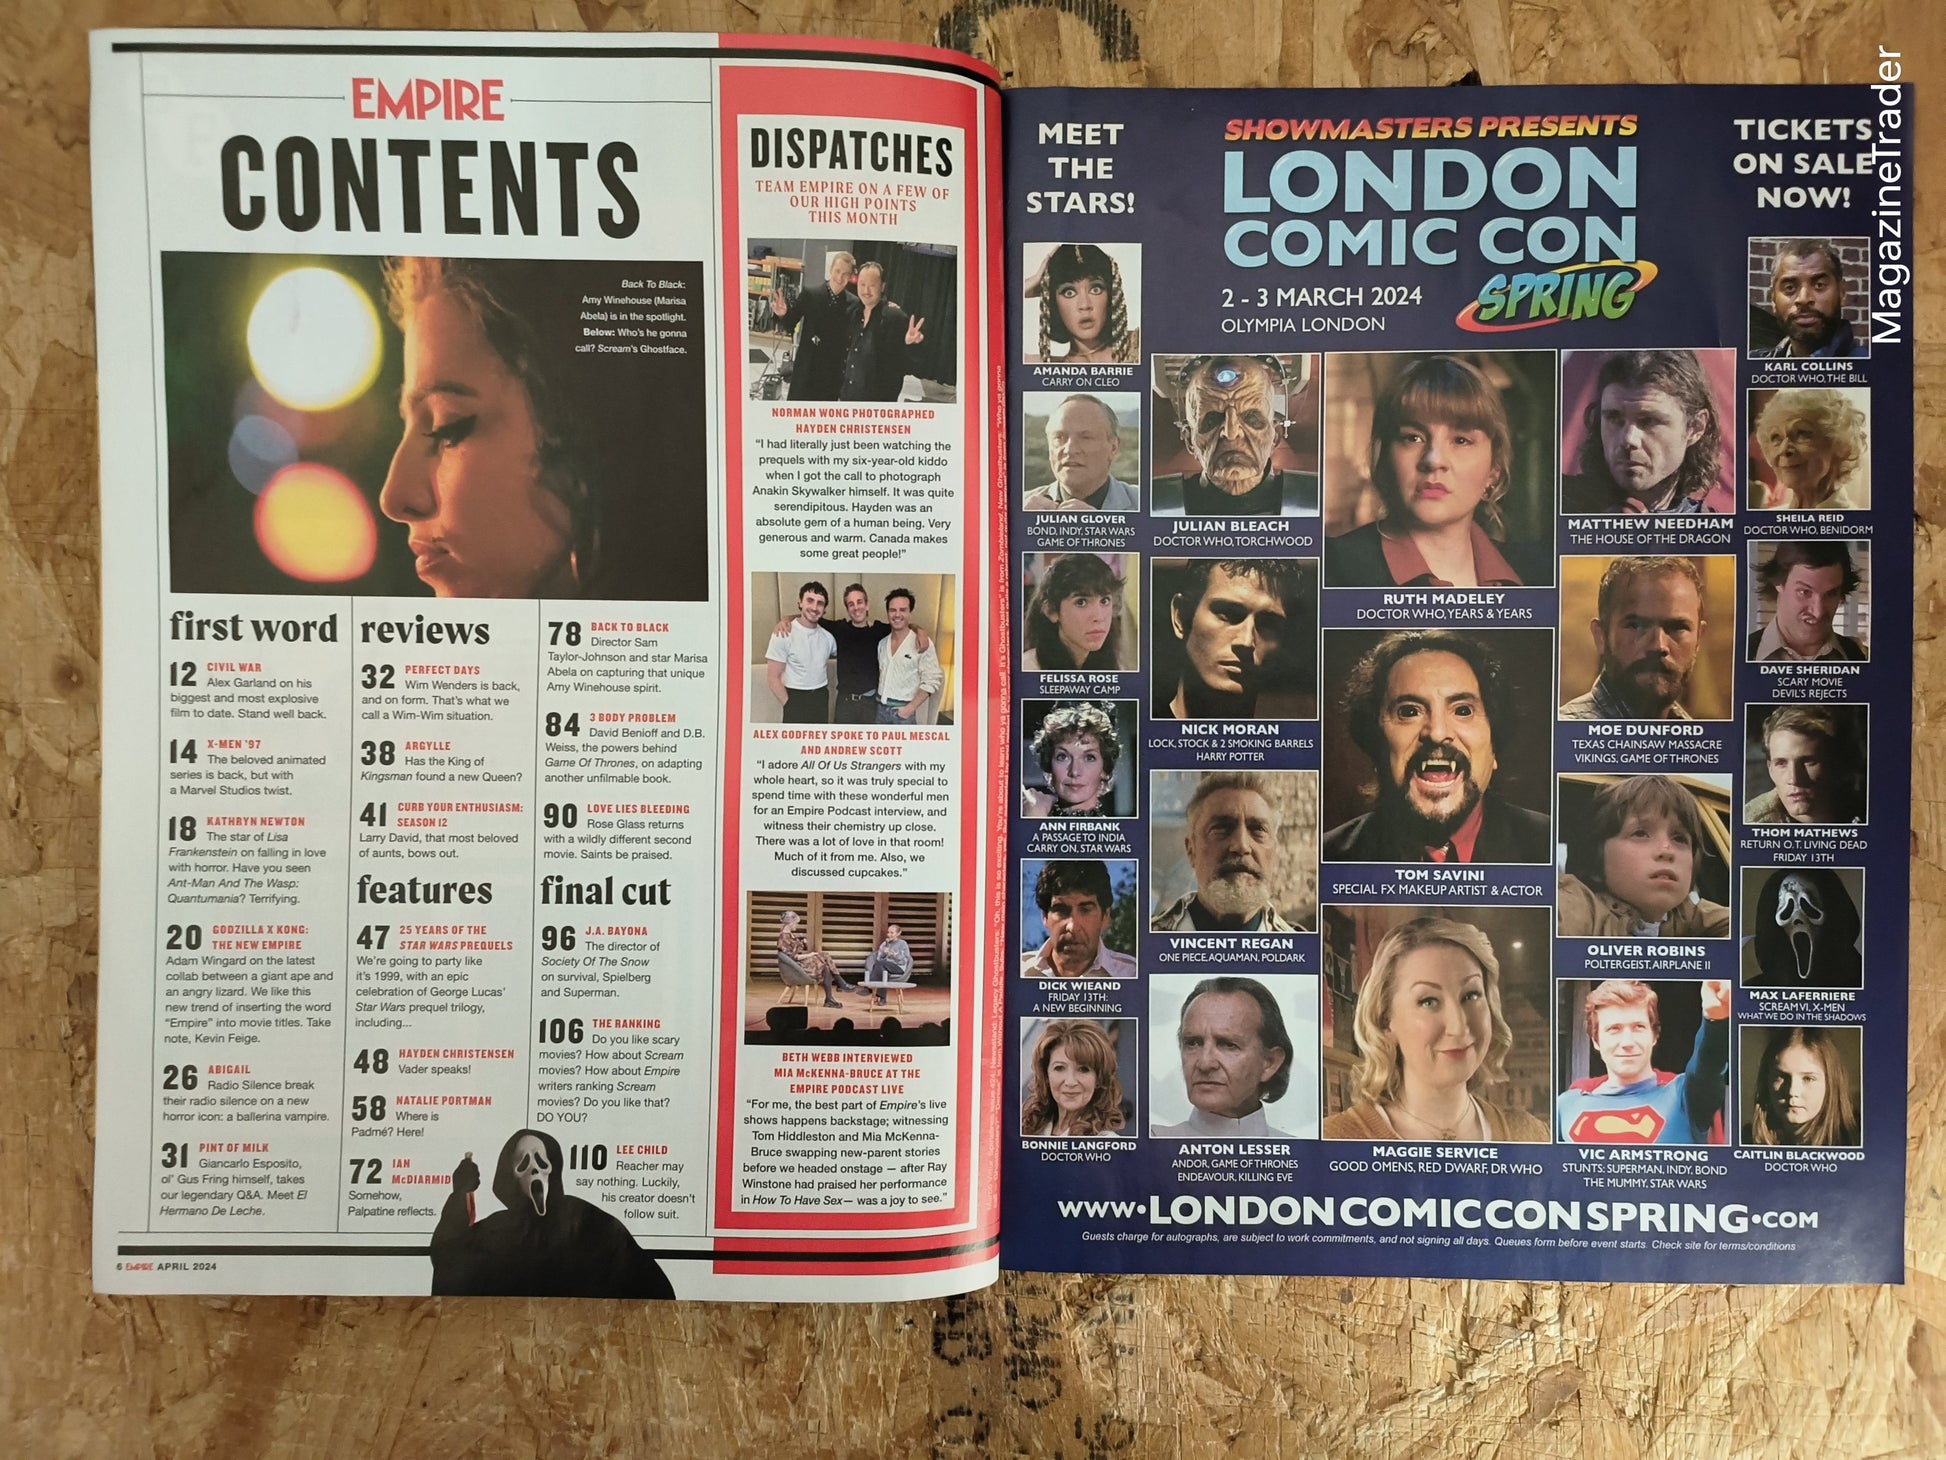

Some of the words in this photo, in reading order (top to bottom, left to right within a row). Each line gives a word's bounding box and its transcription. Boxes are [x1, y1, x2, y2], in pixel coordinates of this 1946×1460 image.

[351, 77, 504, 121] EMPIRE
[1038, 122, 1124, 144] MEET
[1224, 117, 1472, 141] SHOWMASTERS
[1479, 114, 1637, 138] PRESENTS
[1734, 119, 1872, 141] TICKETS
[751, 125, 955, 177] DISPATCHES
[1047, 157, 1113, 179] THE
[1733, 153, 1782, 175] ON
[1794, 153, 1873, 175] SALE
[220, 134, 639, 239] CONTENTS
[1223, 147, 1637, 213] LONDON
[755, 179, 793, 193] TEAM
[799, 180, 853, 195] EMPIRE
[858, 182, 877, 195] ON
[882, 183, 891, 196] A
[897, 184, 926, 199] FEW
[932, 186, 949, 201] OF
[1757, 186, 1850, 208] NOW!
[789, 194, 819, 208] OUR
[824, 195, 859, 210] HIGH
[864, 197, 916, 212] POINTS
[1026, 191, 1134, 213] STARS!
[808, 209, 841, 224] THIS
[846, 210, 897, 226] MONTH
[1223, 219, 1457, 268] COMIC
[1479, 215, 1637, 264] CON
[621, 278, 644, 289] Back
[646, 278, 657, 289] To
[658, 279, 686, 289] Black:
[1222, 288, 1234, 307] 2
[1257, 287, 1268, 307] 3
[1276, 286, 1363, 307] MARCH
[1371, 285, 1422, 305] 2024
[1477, 270, 1635, 322] SPRING
[1221, 317, 1296, 333] OLYMPIA
[1302, 316, 1384, 331] LONDON
[1033, 365, 1087, 376] AMANDA
[1090, 365, 1133, 376] BARRIE
[1764, 361, 1798, 372] KARL
[1801, 361, 1853, 372] COLLINS
[1035, 513, 1077, 526] JULIAN
[1080, 513, 1125, 524] GLOVER
[1567, 517, 1650, 530] MATTHEW
[1654, 517, 1733, 530] NEEDHAM
[1776, 513, 1815, 523] SHEILA
[1818, 513, 1844, 523] REID
[1172, 519, 1225, 535] JULIAN
[1230, 519, 1289, 532] BLEACH
[1383, 592, 1427, 605] RUTH
[1432, 592, 1505, 605] MADELEY
[169, 610, 243, 641] first
[250, 613, 337, 642] word
[360, 614, 489, 644] reviews
[548, 621, 581, 646] 78
[591, 621, 617, 632] BACK
[620, 621, 633, 632] TO
[636, 621, 669, 633] BLACK
[170, 661, 196, 686] 12
[207, 661, 235, 672] CIVIL
[238, 661, 261, 673] WAR
[1760, 664, 1792, 675] DAVE
[1796, 664, 1859, 675] SHERIDAN
[361, 663, 394, 689] 32
[1040, 673, 1085, 683] FELISSA
[1088, 673, 1118, 684] ROSE
[545, 711, 580, 736] 84
[1181, 723, 1218, 735] NICK
[1222, 723, 1279, 736] MORAN
[1588, 723, 1622, 736] MOE
[1626, 723, 1703, 736] DUNFORD
[170, 739, 197, 763] 14
[361, 740, 395, 765] 38
[405, 740, 451, 751] ARGYLLE
[1196, 751, 1227, 762] HARRY
[1229, 751, 1264, 762] POTTER
[359, 802, 386, 826] 41
[543, 802, 579, 830] 90
[587, 802, 612, 814] LOVE
[615, 803, 637, 814] LIES
[640, 803, 689, 815] BLEEDING
[168, 815, 196, 841] 18
[1039, 821, 1066, 833] ANN
[1069, 821, 1120, 833] FIRBANK
[1751, 827, 1790, 838] THOM
[1793, 827, 1857, 838] MATHEWS
[791, 865, 845, 877] discussed
[1394, 868, 1428, 881] TOM
[1433, 868, 1484, 882] SAVINI
[356, 873, 492, 904] features
[540, 874, 613, 904] final
[622, 878, 671, 905] cut
[166, 924, 201, 950] 20
[356, 925, 390, 949] 47
[540, 925, 577, 952] 96
[585, 925, 604, 936] J.A.
[607, 925, 647, 936] BAYONA
[1169, 937, 1237, 950] VINCENT
[1241, 937, 1293, 950] REGAN
[1587, 943, 1642, 957] OLIVER
[1647, 944, 1705, 957] ROBINS
[1039, 980, 1067, 991] DICK
[1070, 980, 1121, 991] WIEAND
[1749, 989, 1778, 1001] MAX
[1781, 989, 1856, 1001] LAFERRIERE
[538, 1017, 585, 1046] 106
[353, 1048, 388, 1074] 48
[782, 1051, 808, 1063] BETH
[811, 1051, 839, 1063] WEBB
[842, 1051, 912, 1063] INTERVIEWED
[163, 1064, 197, 1090] 26
[208, 1063, 251, 1075] ABIGAIL
[398, 1062, 429, 1075] Vader
[431, 1063, 471, 1077] speaks!
[538, 1064, 581, 1076] movies?
[584, 1064, 608, 1076] How
[611, 1064, 641, 1076] about
[643, 1064, 680, 1078] Empire
[351, 1095, 386, 1121] 58
[396, 1094, 439, 1106] NATALIE
[441, 1094, 492, 1106] PORTMAN
[199, 1142, 224, 1153] PINT
[226, 1142, 239, 1153] OF
[242, 1142, 268, 1153] MILK
[616, 1143, 634, 1155] LEE
[637, 1144, 667, 1155] CHILD
[1021, 1139, 1068, 1150] BONNIE
[1071, 1140, 1136, 1151] LANGFORD
[1178, 1142, 1233, 1155] ANTON
[1239, 1143, 1290, 1156] LESSER
[1373, 1145, 1431, 1158] MAGGIE
[1436, 1146, 1498, 1159] SERVICE
[161, 1142, 188, 1168] 31
[568, 1142, 608, 1171] 110
[1041, 1151, 1083, 1162] DOCTOR
[1084, 1151, 1111, 1162] WHO
[1578, 1147, 1605, 1160] VIC
[1608, 1148, 1708, 1162] ARMSTRONG
[1733, 1149, 1783, 1160] CAITLIN
[1786, 1150, 1865, 1161] BLACKWOOD
[349, 1158, 382, 1184] 72
[1081, 1230, 1115, 1241] Guests
[1116, 1230, 1149, 1244] charge
[1150, 1230, 1164, 1242] for
[1165, 1231, 1219, 1244] autographs,
[156, 1261, 189, 1271] APRIL
[192, 1261, 216, 1271] 2024
